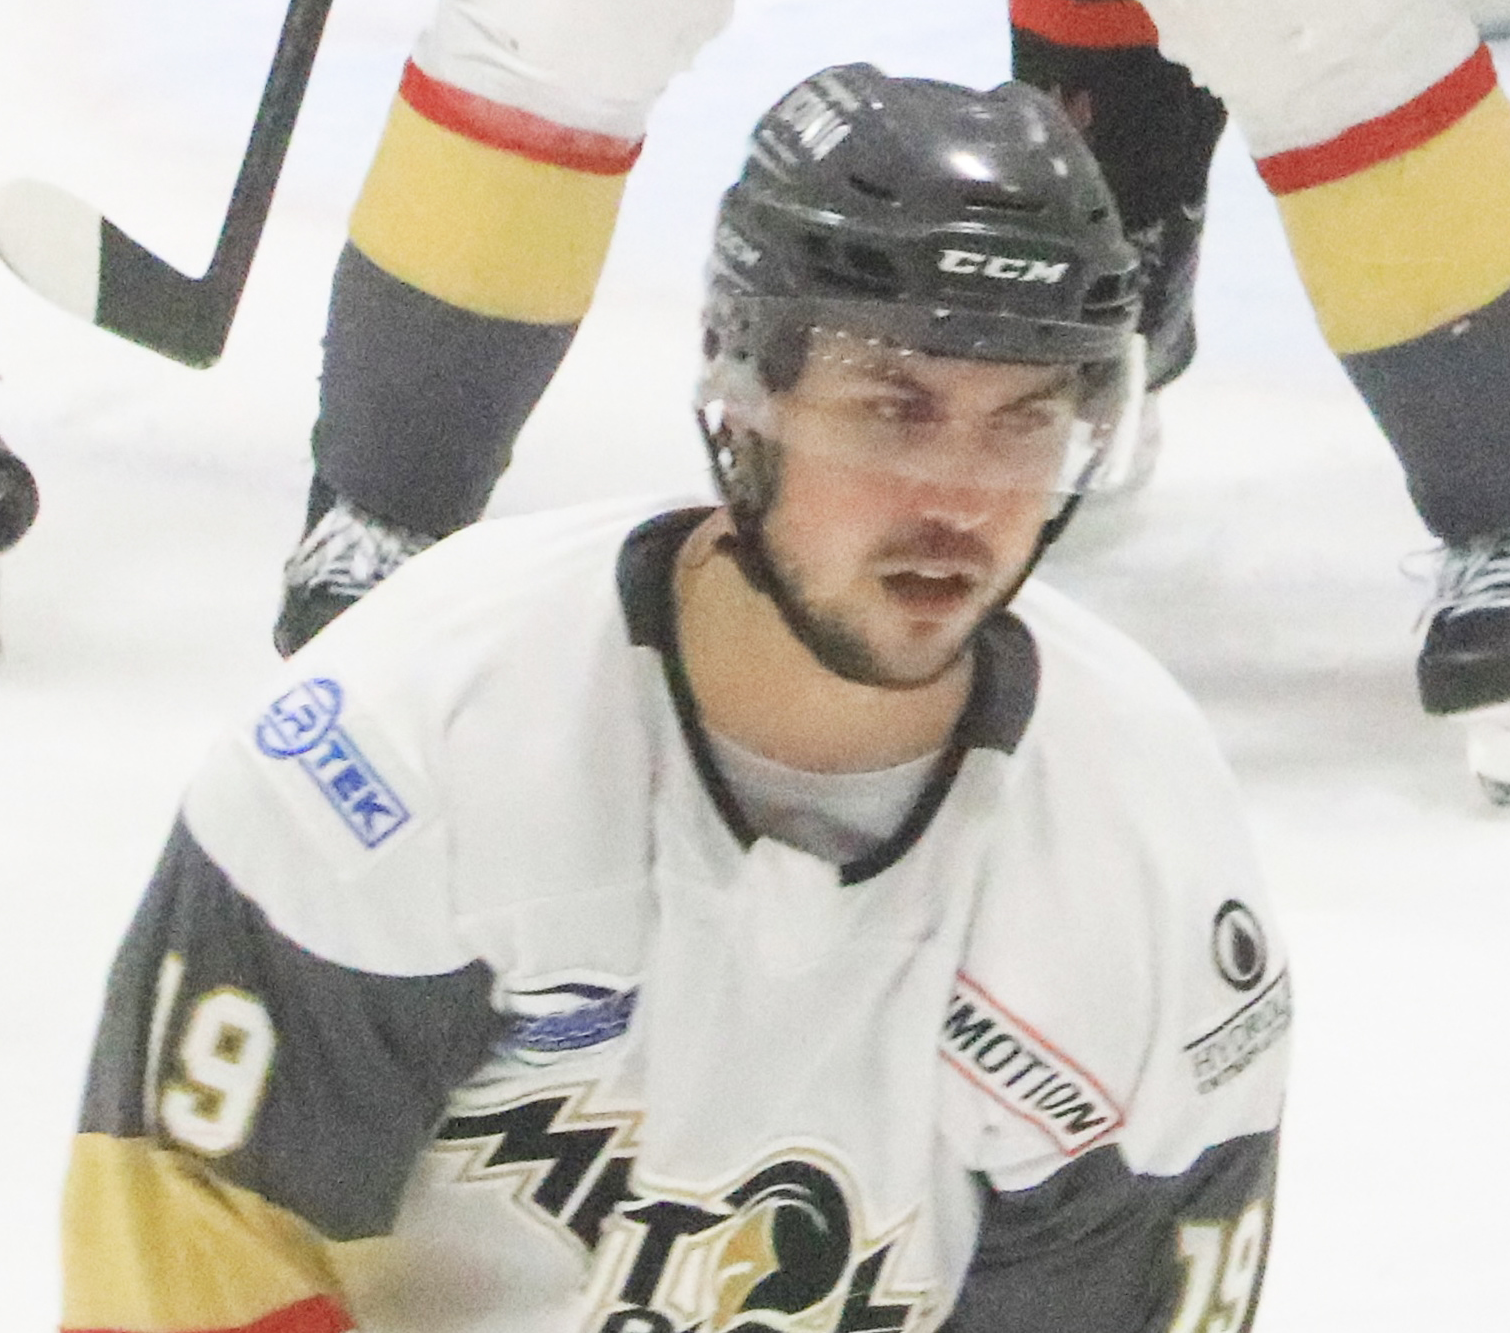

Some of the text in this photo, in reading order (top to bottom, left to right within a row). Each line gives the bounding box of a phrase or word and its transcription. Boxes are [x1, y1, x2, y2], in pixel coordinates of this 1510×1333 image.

[937, 247, 1071, 285] CCM
[311, 741, 396, 832] TEK
[141, 949, 279, 1160] 19
[943, 999, 1108, 1137] MOTION
